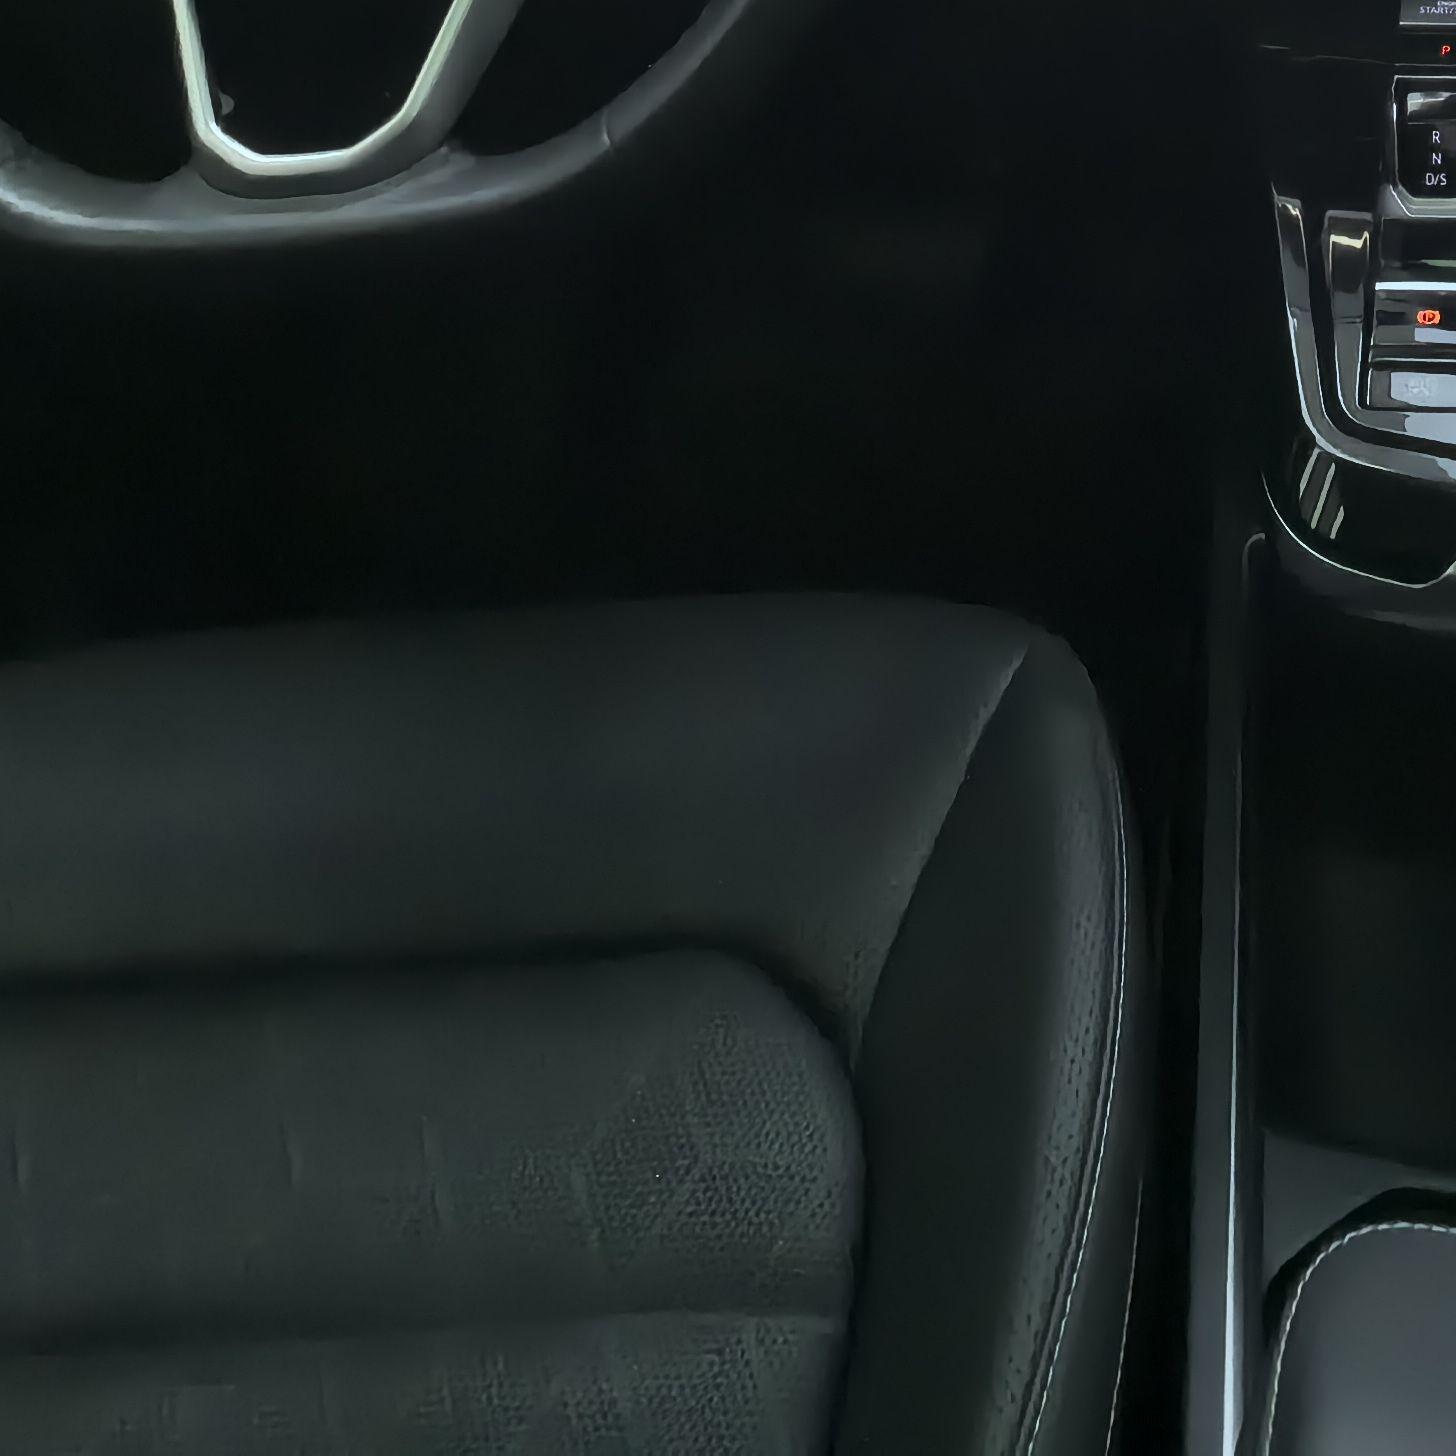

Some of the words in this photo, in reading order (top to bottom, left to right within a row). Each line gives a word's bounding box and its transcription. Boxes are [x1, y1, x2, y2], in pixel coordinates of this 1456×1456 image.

[1441, 45, 1451, 55] P
[1432, 130, 1441, 143] R
[1432, 152, 1442, 165] N
[1425, 172, 1447, 186] D/S
